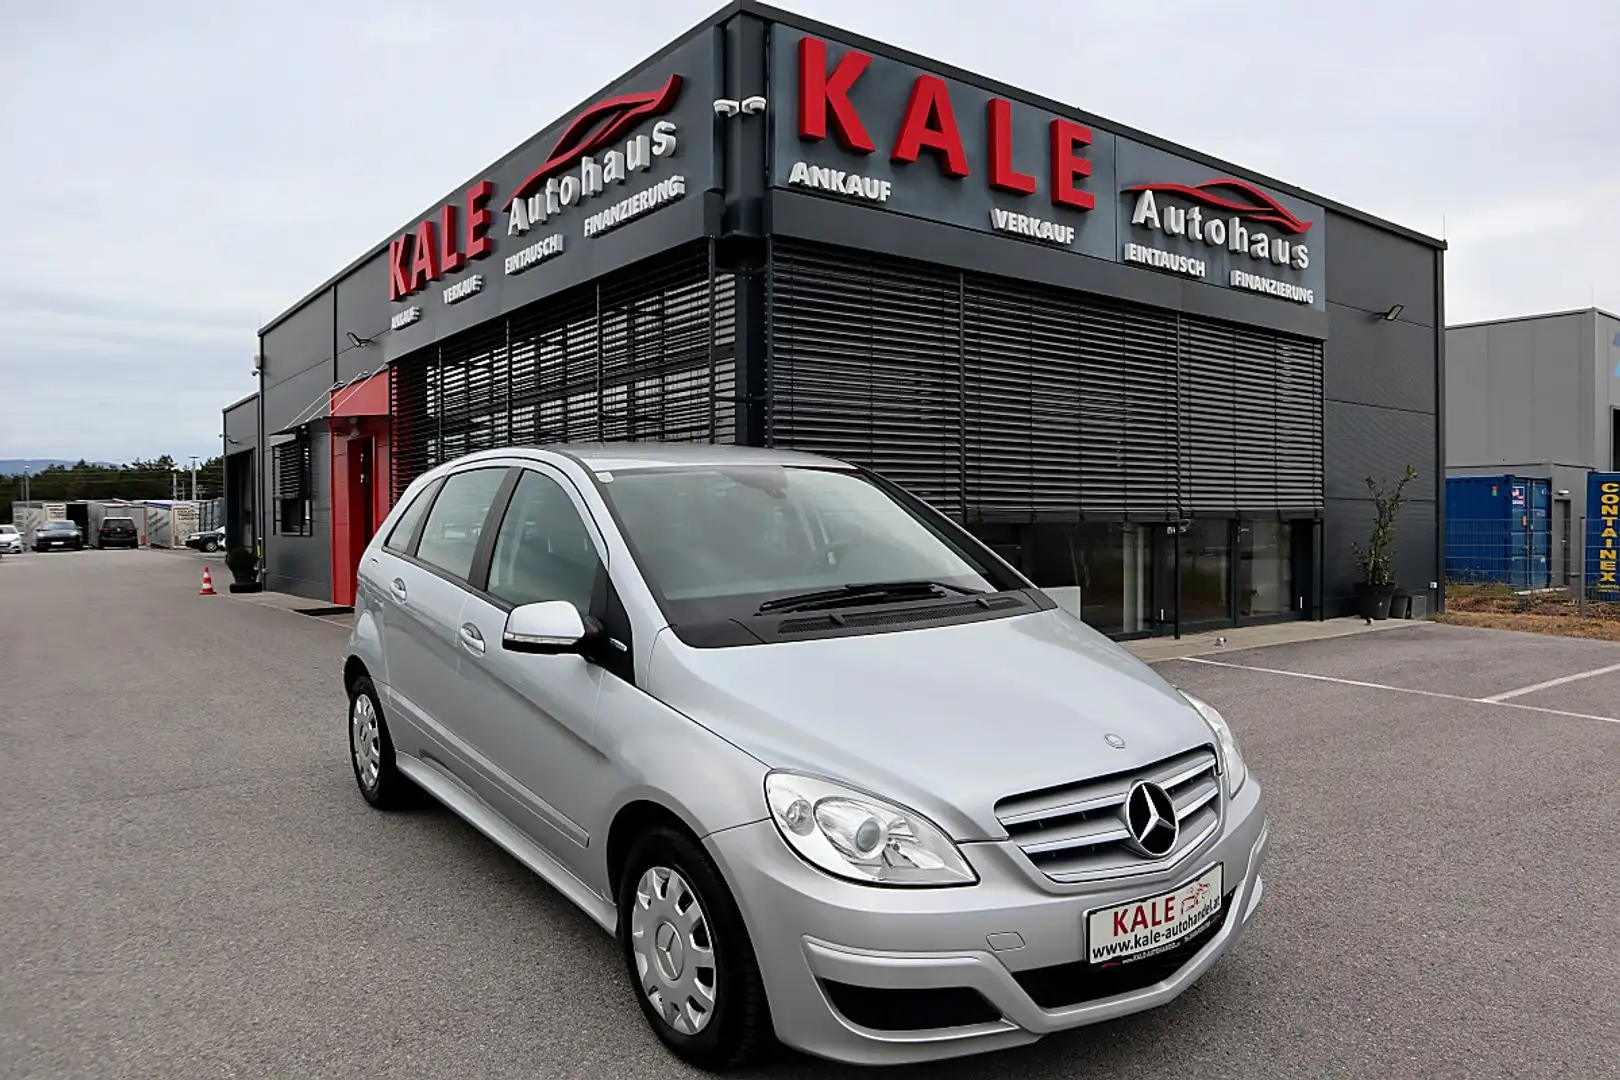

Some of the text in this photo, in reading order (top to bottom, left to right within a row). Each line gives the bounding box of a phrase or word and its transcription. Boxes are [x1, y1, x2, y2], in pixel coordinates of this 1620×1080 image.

[798, 36, 1094, 211] KALE
[507, 120, 677, 236] Autohaus
[584, 175, 686, 238] FINANZIERUNG
[788, 162, 892, 203] ANKAUF
[388, 180, 492, 302] KALE
[504, 233, 564, 276] EINTAUSCH
[990, 207, 1075, 245] VERKAUF
[1131, 189, 1309, 270] Autohaus
[1124, 243, 1206, 278] EINTAUSCH
[1229, 269, 1314, 304] FINANZIERUNG
[1599, 482, 1620, 582] CONTAINEX
[1092, 895, 1221, 959] www.kale-autohandel.at
[1113, 896, 1176, 937] KALE
